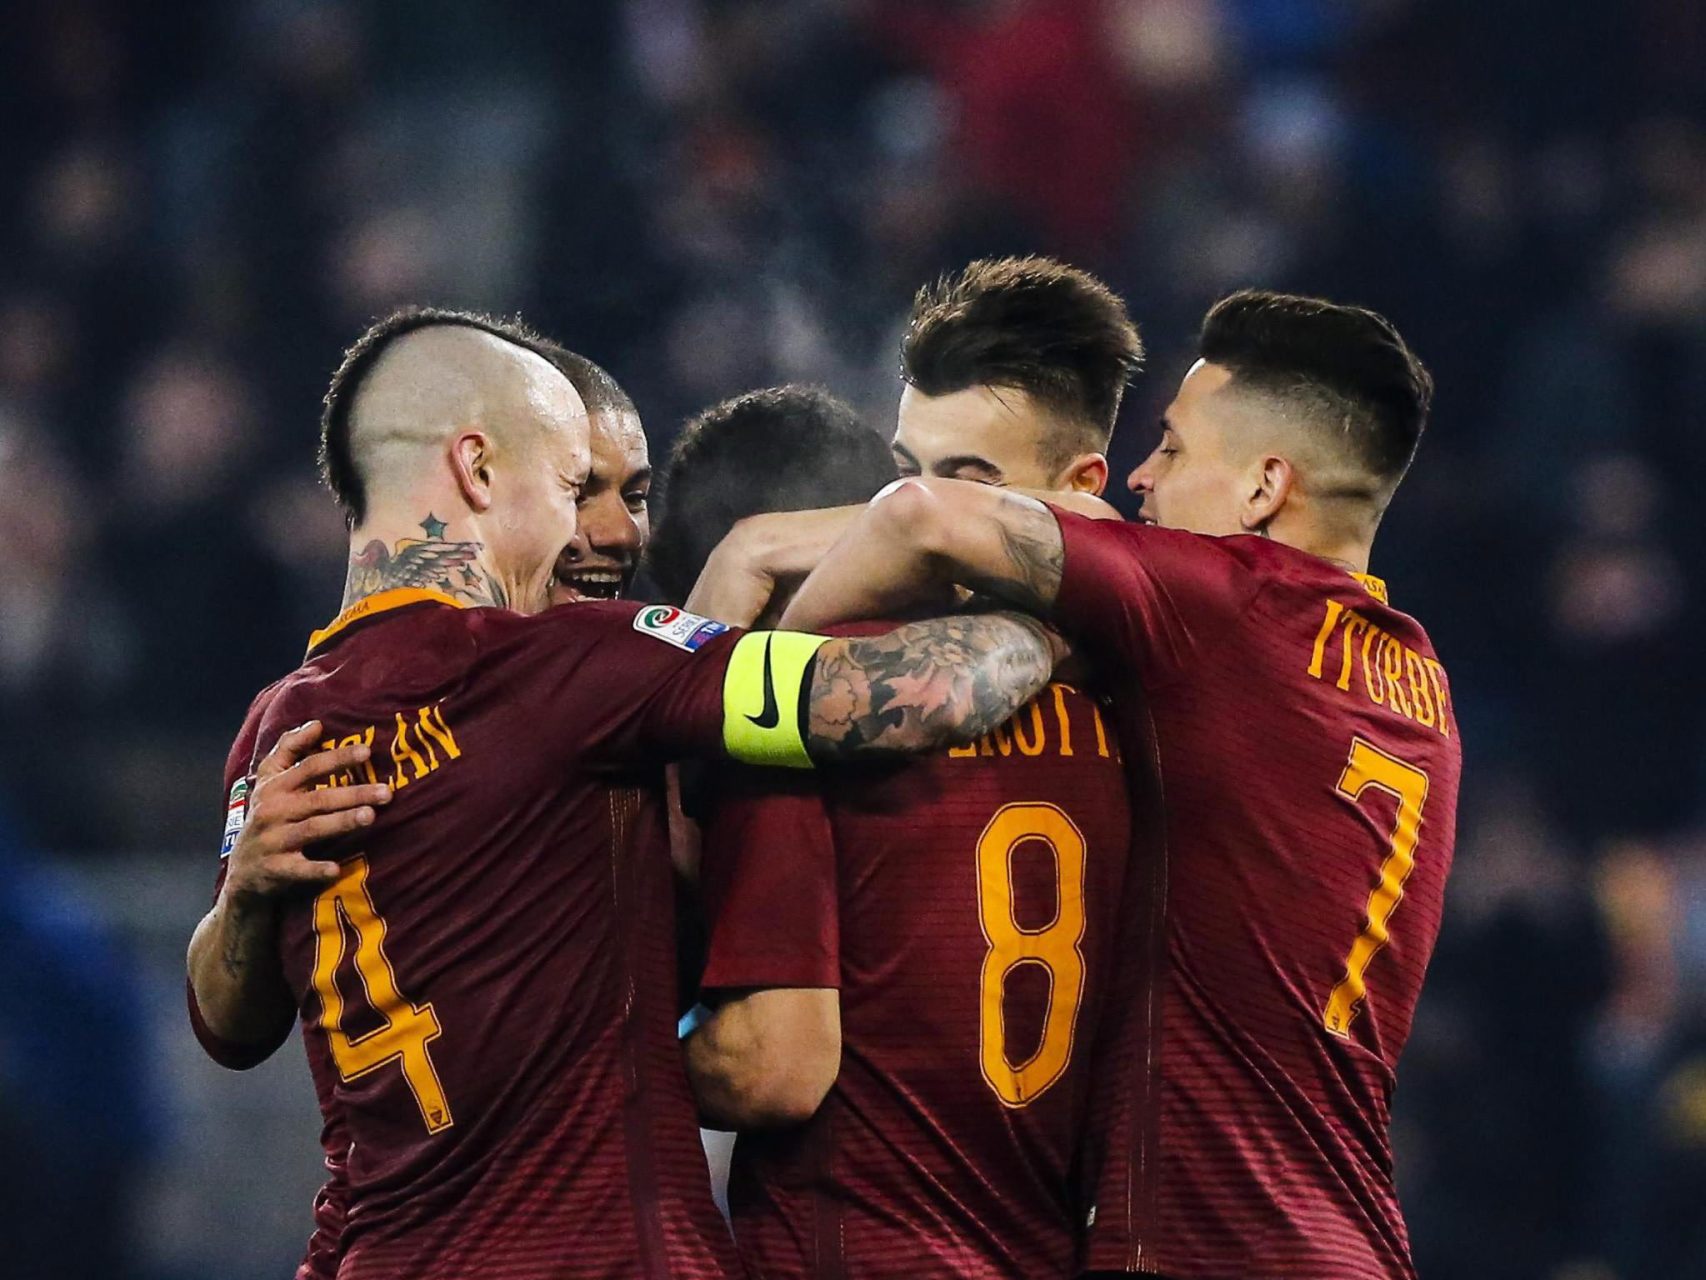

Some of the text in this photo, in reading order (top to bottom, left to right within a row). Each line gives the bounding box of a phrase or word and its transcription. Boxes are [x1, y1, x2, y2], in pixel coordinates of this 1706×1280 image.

[1308, 599, 1450, 740] ITURBE
[311, 854, 454, 1135] 4
[975, 801, 1088, 1109] 8
[1323, 736, 1430, 1040] 7
